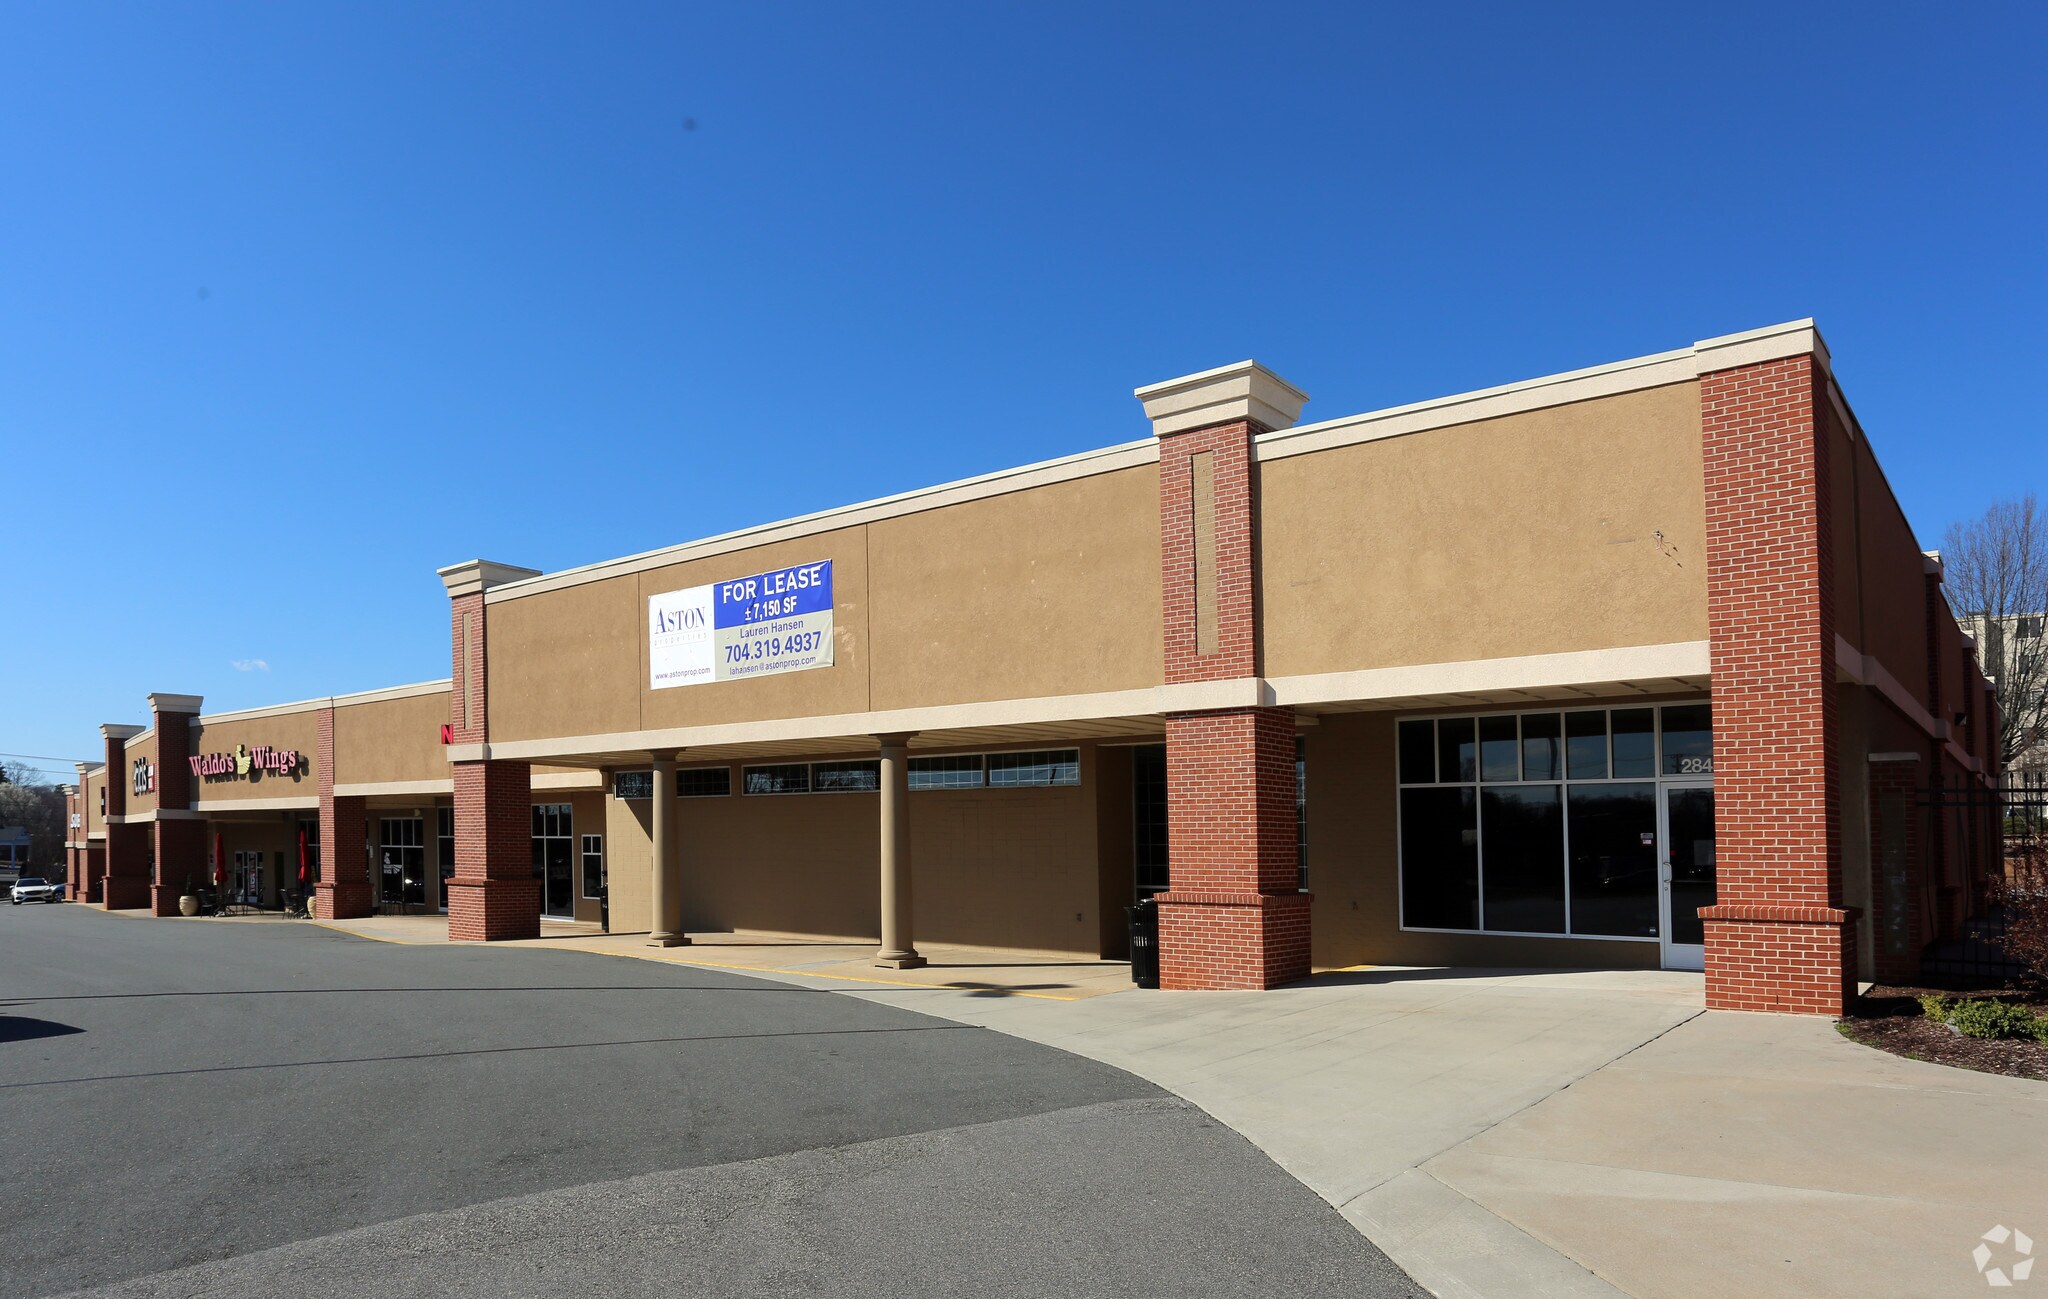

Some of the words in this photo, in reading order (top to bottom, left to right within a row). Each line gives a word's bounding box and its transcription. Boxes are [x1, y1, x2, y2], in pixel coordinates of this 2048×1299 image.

[723, 580, 756, 604] FOR
[764, 566, 821, 596] LEASE
[754, 599, 780, 620] 7,150
[783, 596, 797, 614] SF
[740, 626, 768, 638] Lauren
[771, 620, 804, 633] Hansen
[725, 631, 821, 663] 704.319.4937
[655, 667, 711, 680] www.astonprop.com
[189, 754, 234, 777] Waldo's
[251, 746, 296, 774] Wings
